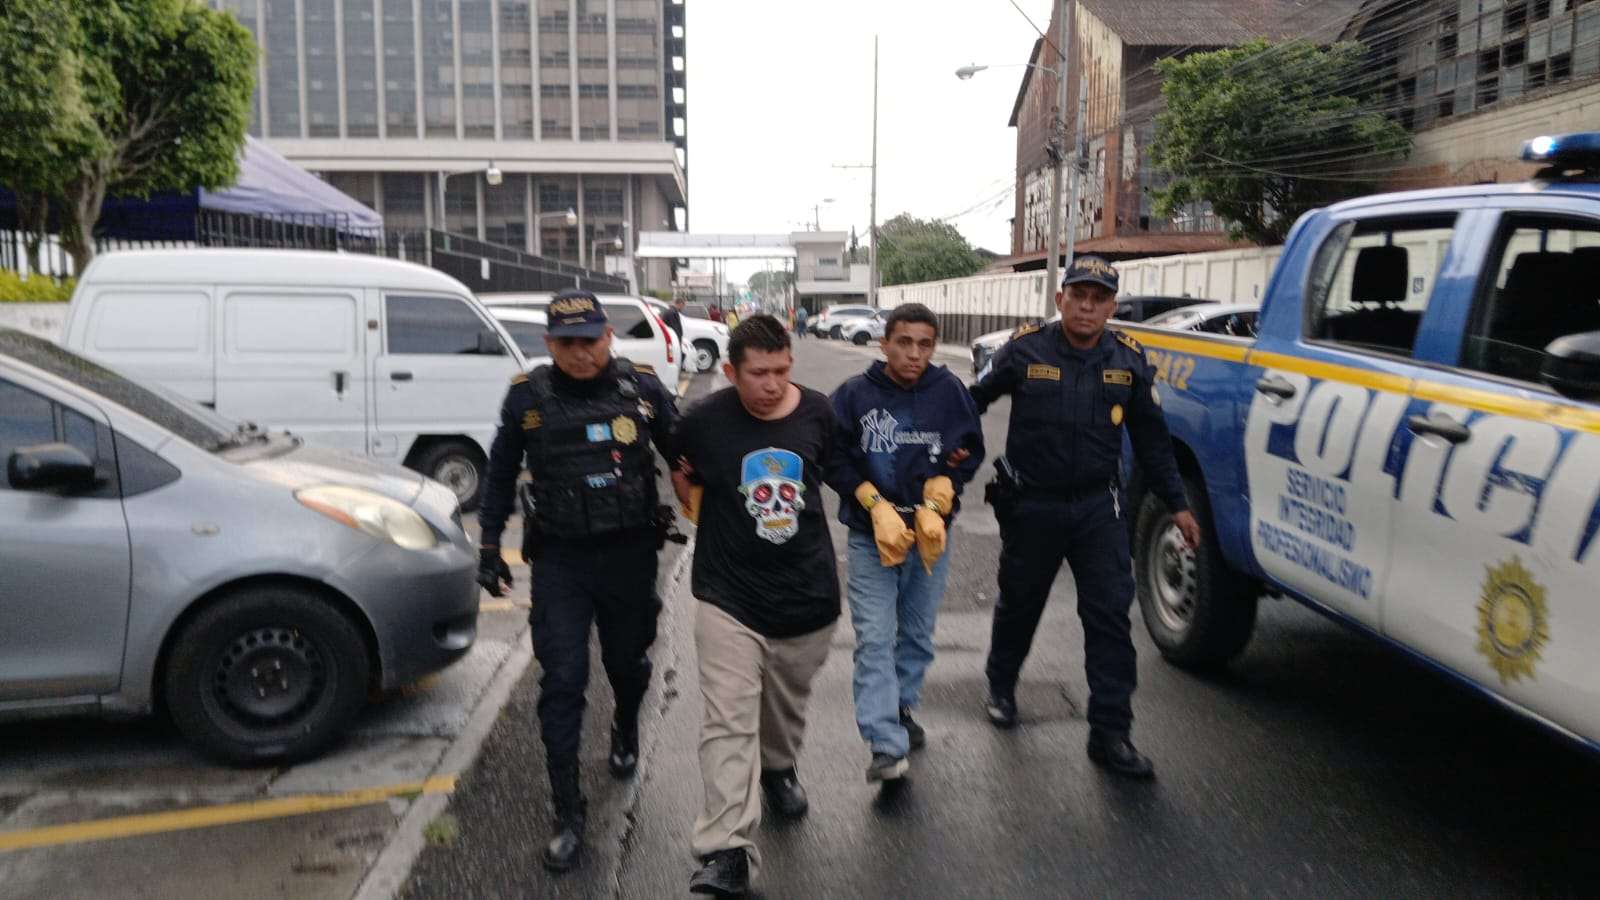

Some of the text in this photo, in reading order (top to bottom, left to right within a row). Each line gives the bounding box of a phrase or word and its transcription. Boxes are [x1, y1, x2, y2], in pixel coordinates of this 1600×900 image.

[859, 408, 899, 454] NY
[1246, 368, 1600, 569] POLICI
[1286, 467, 1346, 515] SERVICIO
[1278, 494, 1354, 554] INTEGRIDAD
[1258, 518, 1371, 600] PROFESIONALISMO
